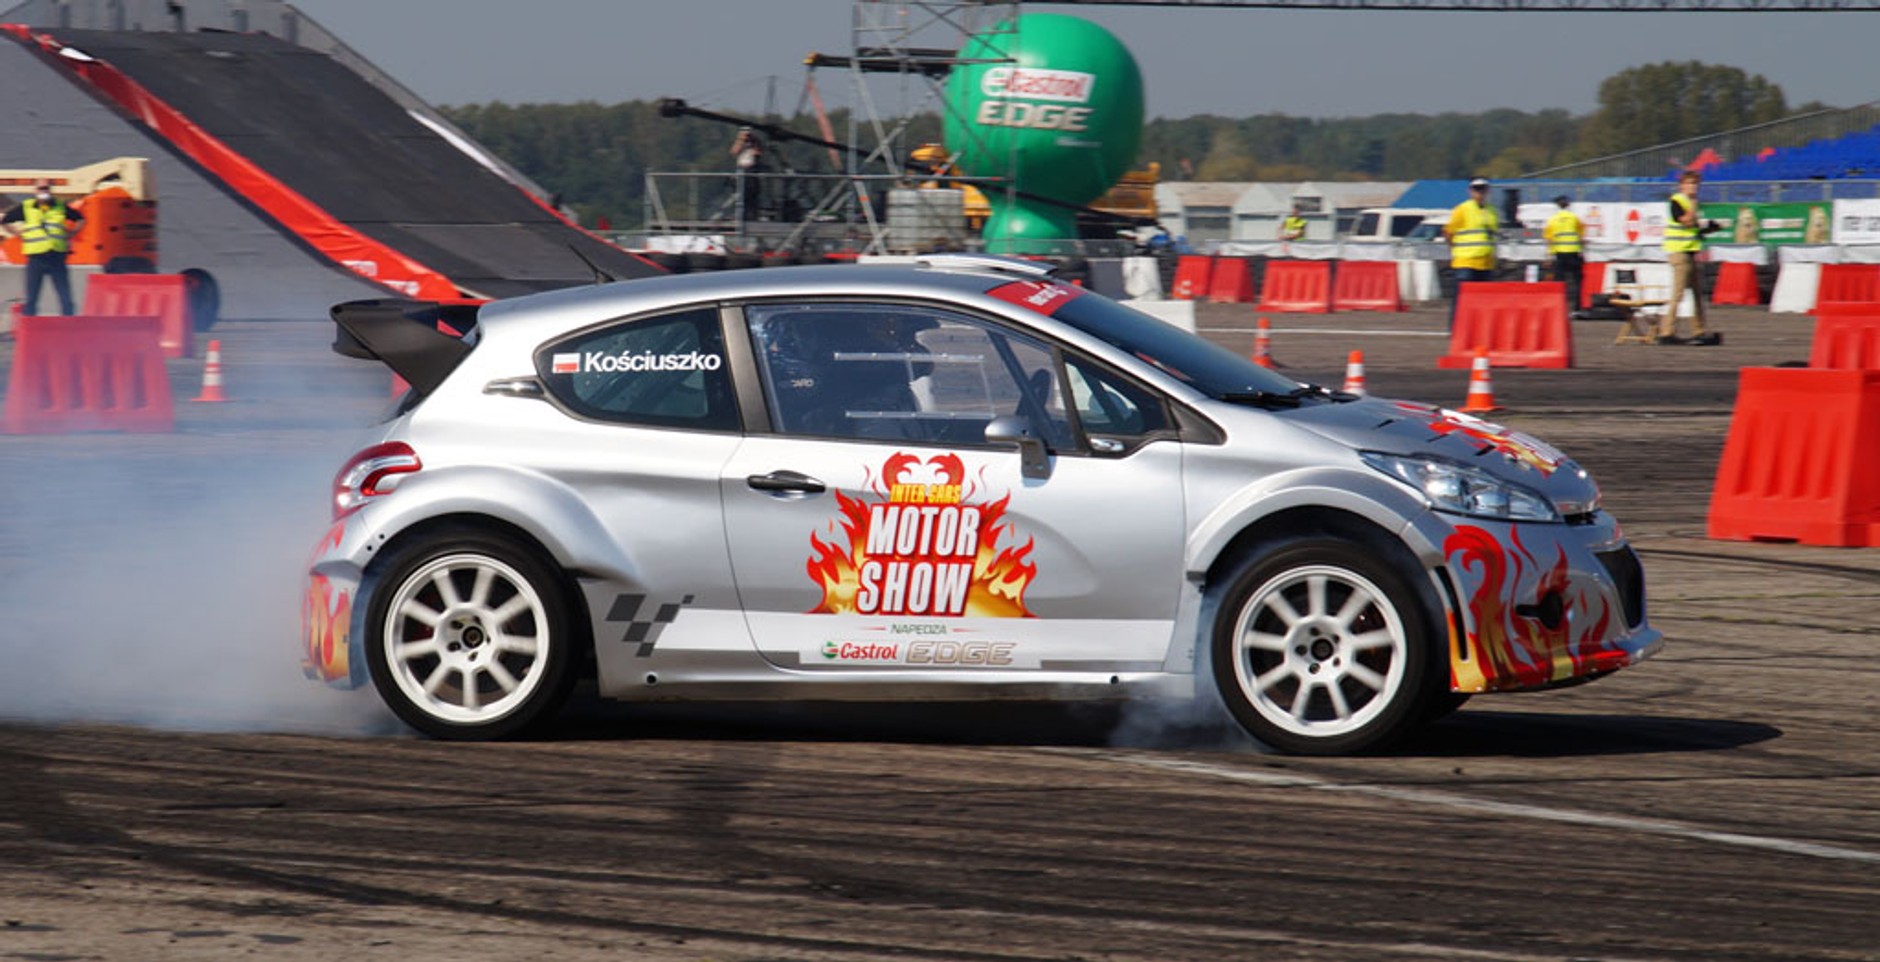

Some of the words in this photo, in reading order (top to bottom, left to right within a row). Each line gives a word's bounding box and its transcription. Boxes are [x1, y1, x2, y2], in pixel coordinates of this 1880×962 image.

[1006, 70, 1089, 98] Castrol
[976, 101, 1095, 133] EDGE
[584, 350, 721, 373] Kościuszko
[890, 484, 926, 503] INTER
[866, 505, 980, 557] MOTOR
[857, 561, 973, 614] SHOW
[840, 642, 900, 661] Castrol
[905, 641, 1017, 665] EDGE
